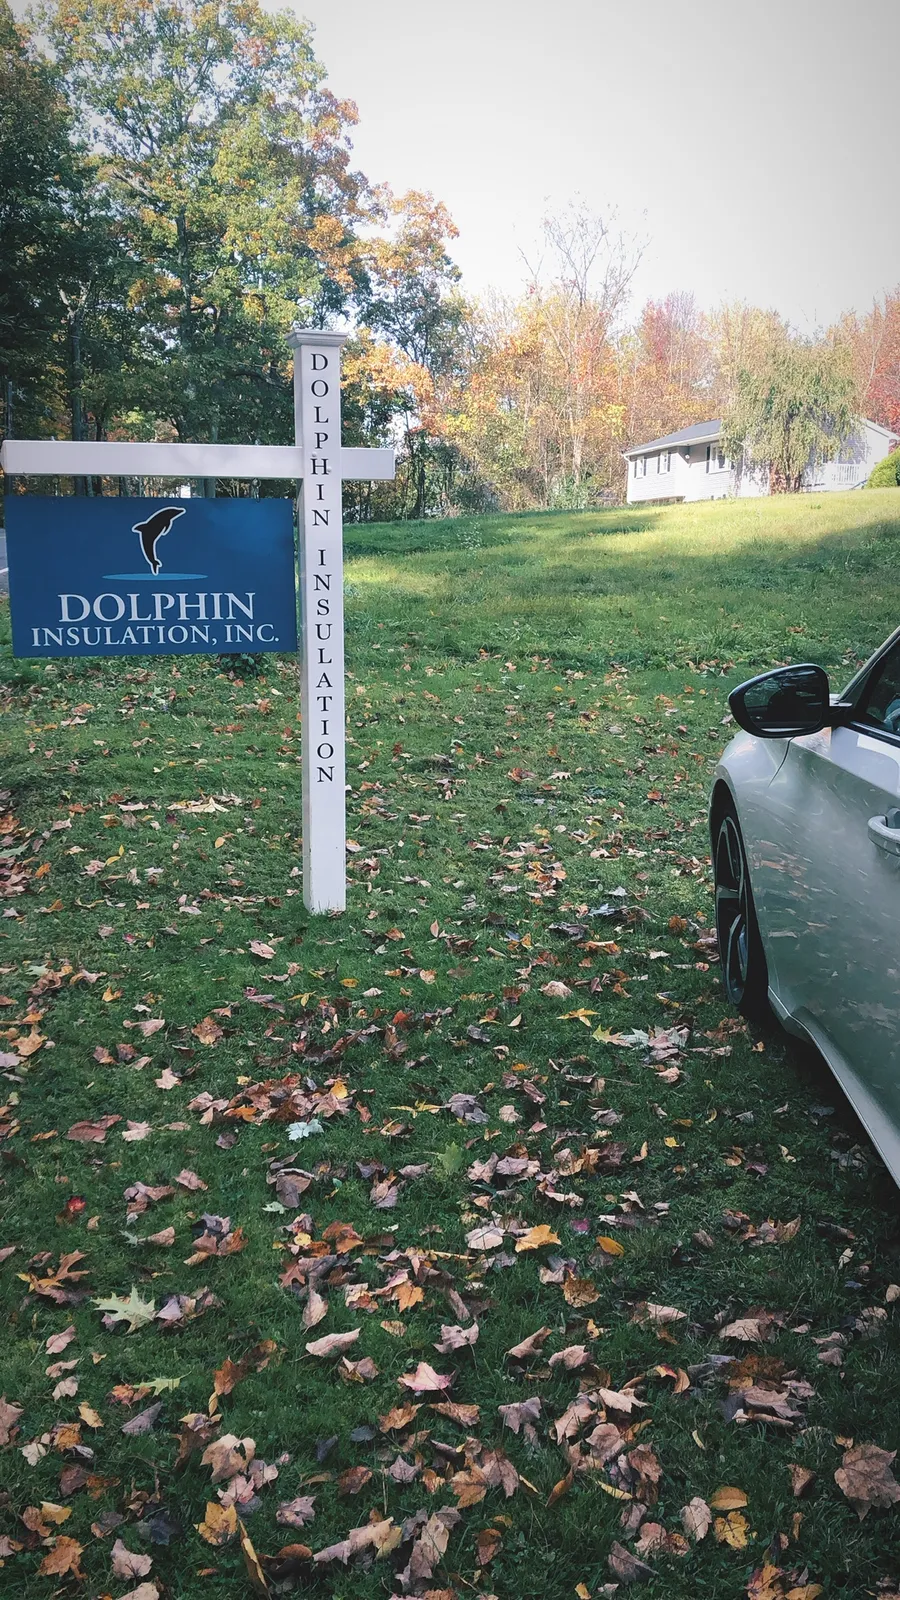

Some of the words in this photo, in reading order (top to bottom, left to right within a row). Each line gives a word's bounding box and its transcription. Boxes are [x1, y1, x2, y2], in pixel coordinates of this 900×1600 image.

[310, 353, 330, 526] DOLPHIN
[31, 624, 217, 647] INSULATION,
[225, 623, 280, 643] INC.
[58, 592, 256, 623] DOLPHIN
[313, 549, 334, 783] INSULATION
